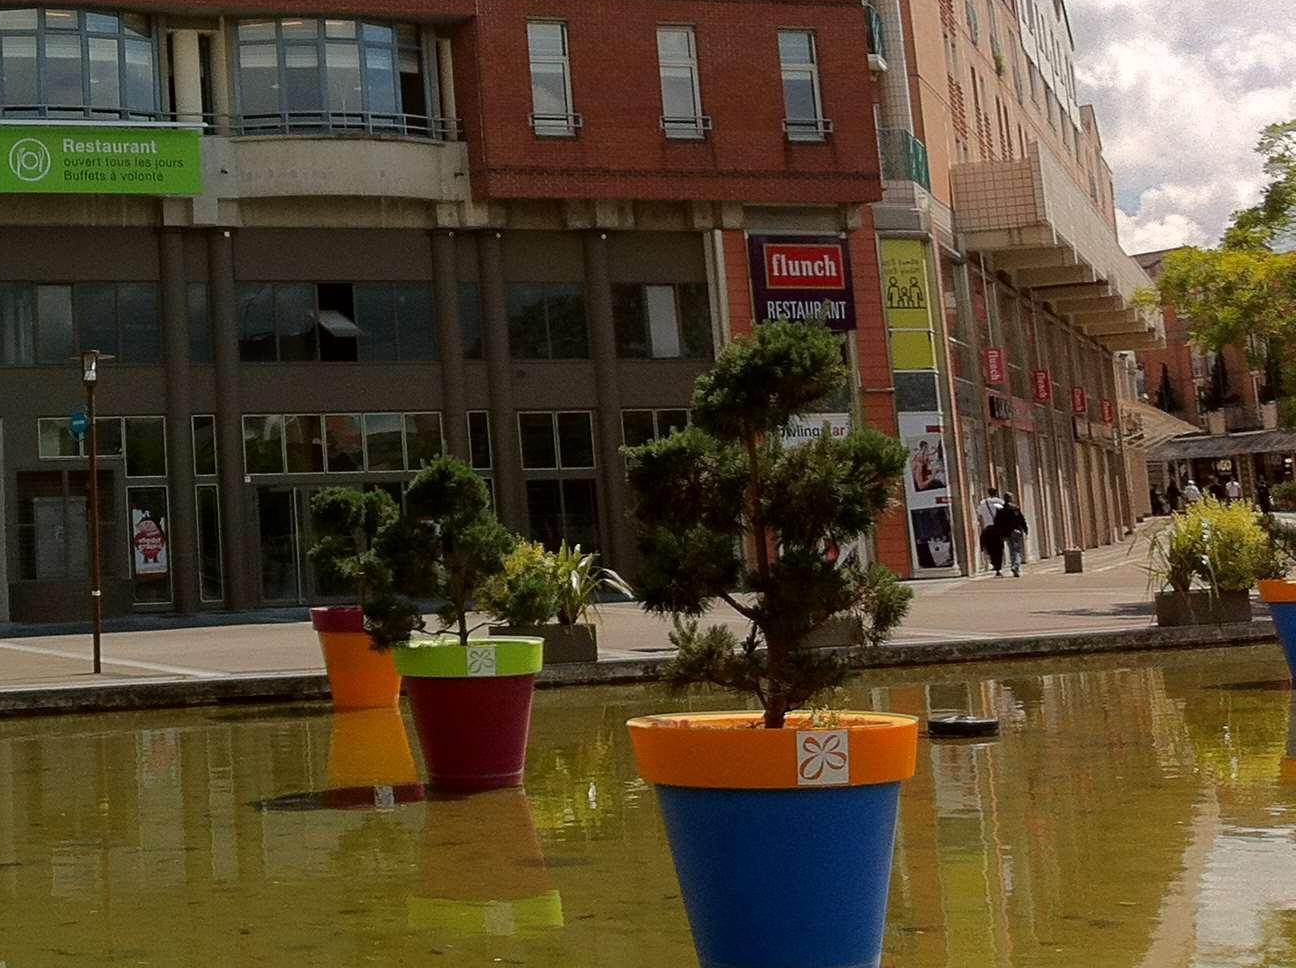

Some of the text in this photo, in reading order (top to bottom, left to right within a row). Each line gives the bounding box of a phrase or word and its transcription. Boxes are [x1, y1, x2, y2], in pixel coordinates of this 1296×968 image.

[63, 138, 158, 154] Restaurant
[63, 156, 184, 171] ouvert tous les jours
[63, 169, 164, 182] Buffets à volonté
[771, 253, 837, 276] flunch
